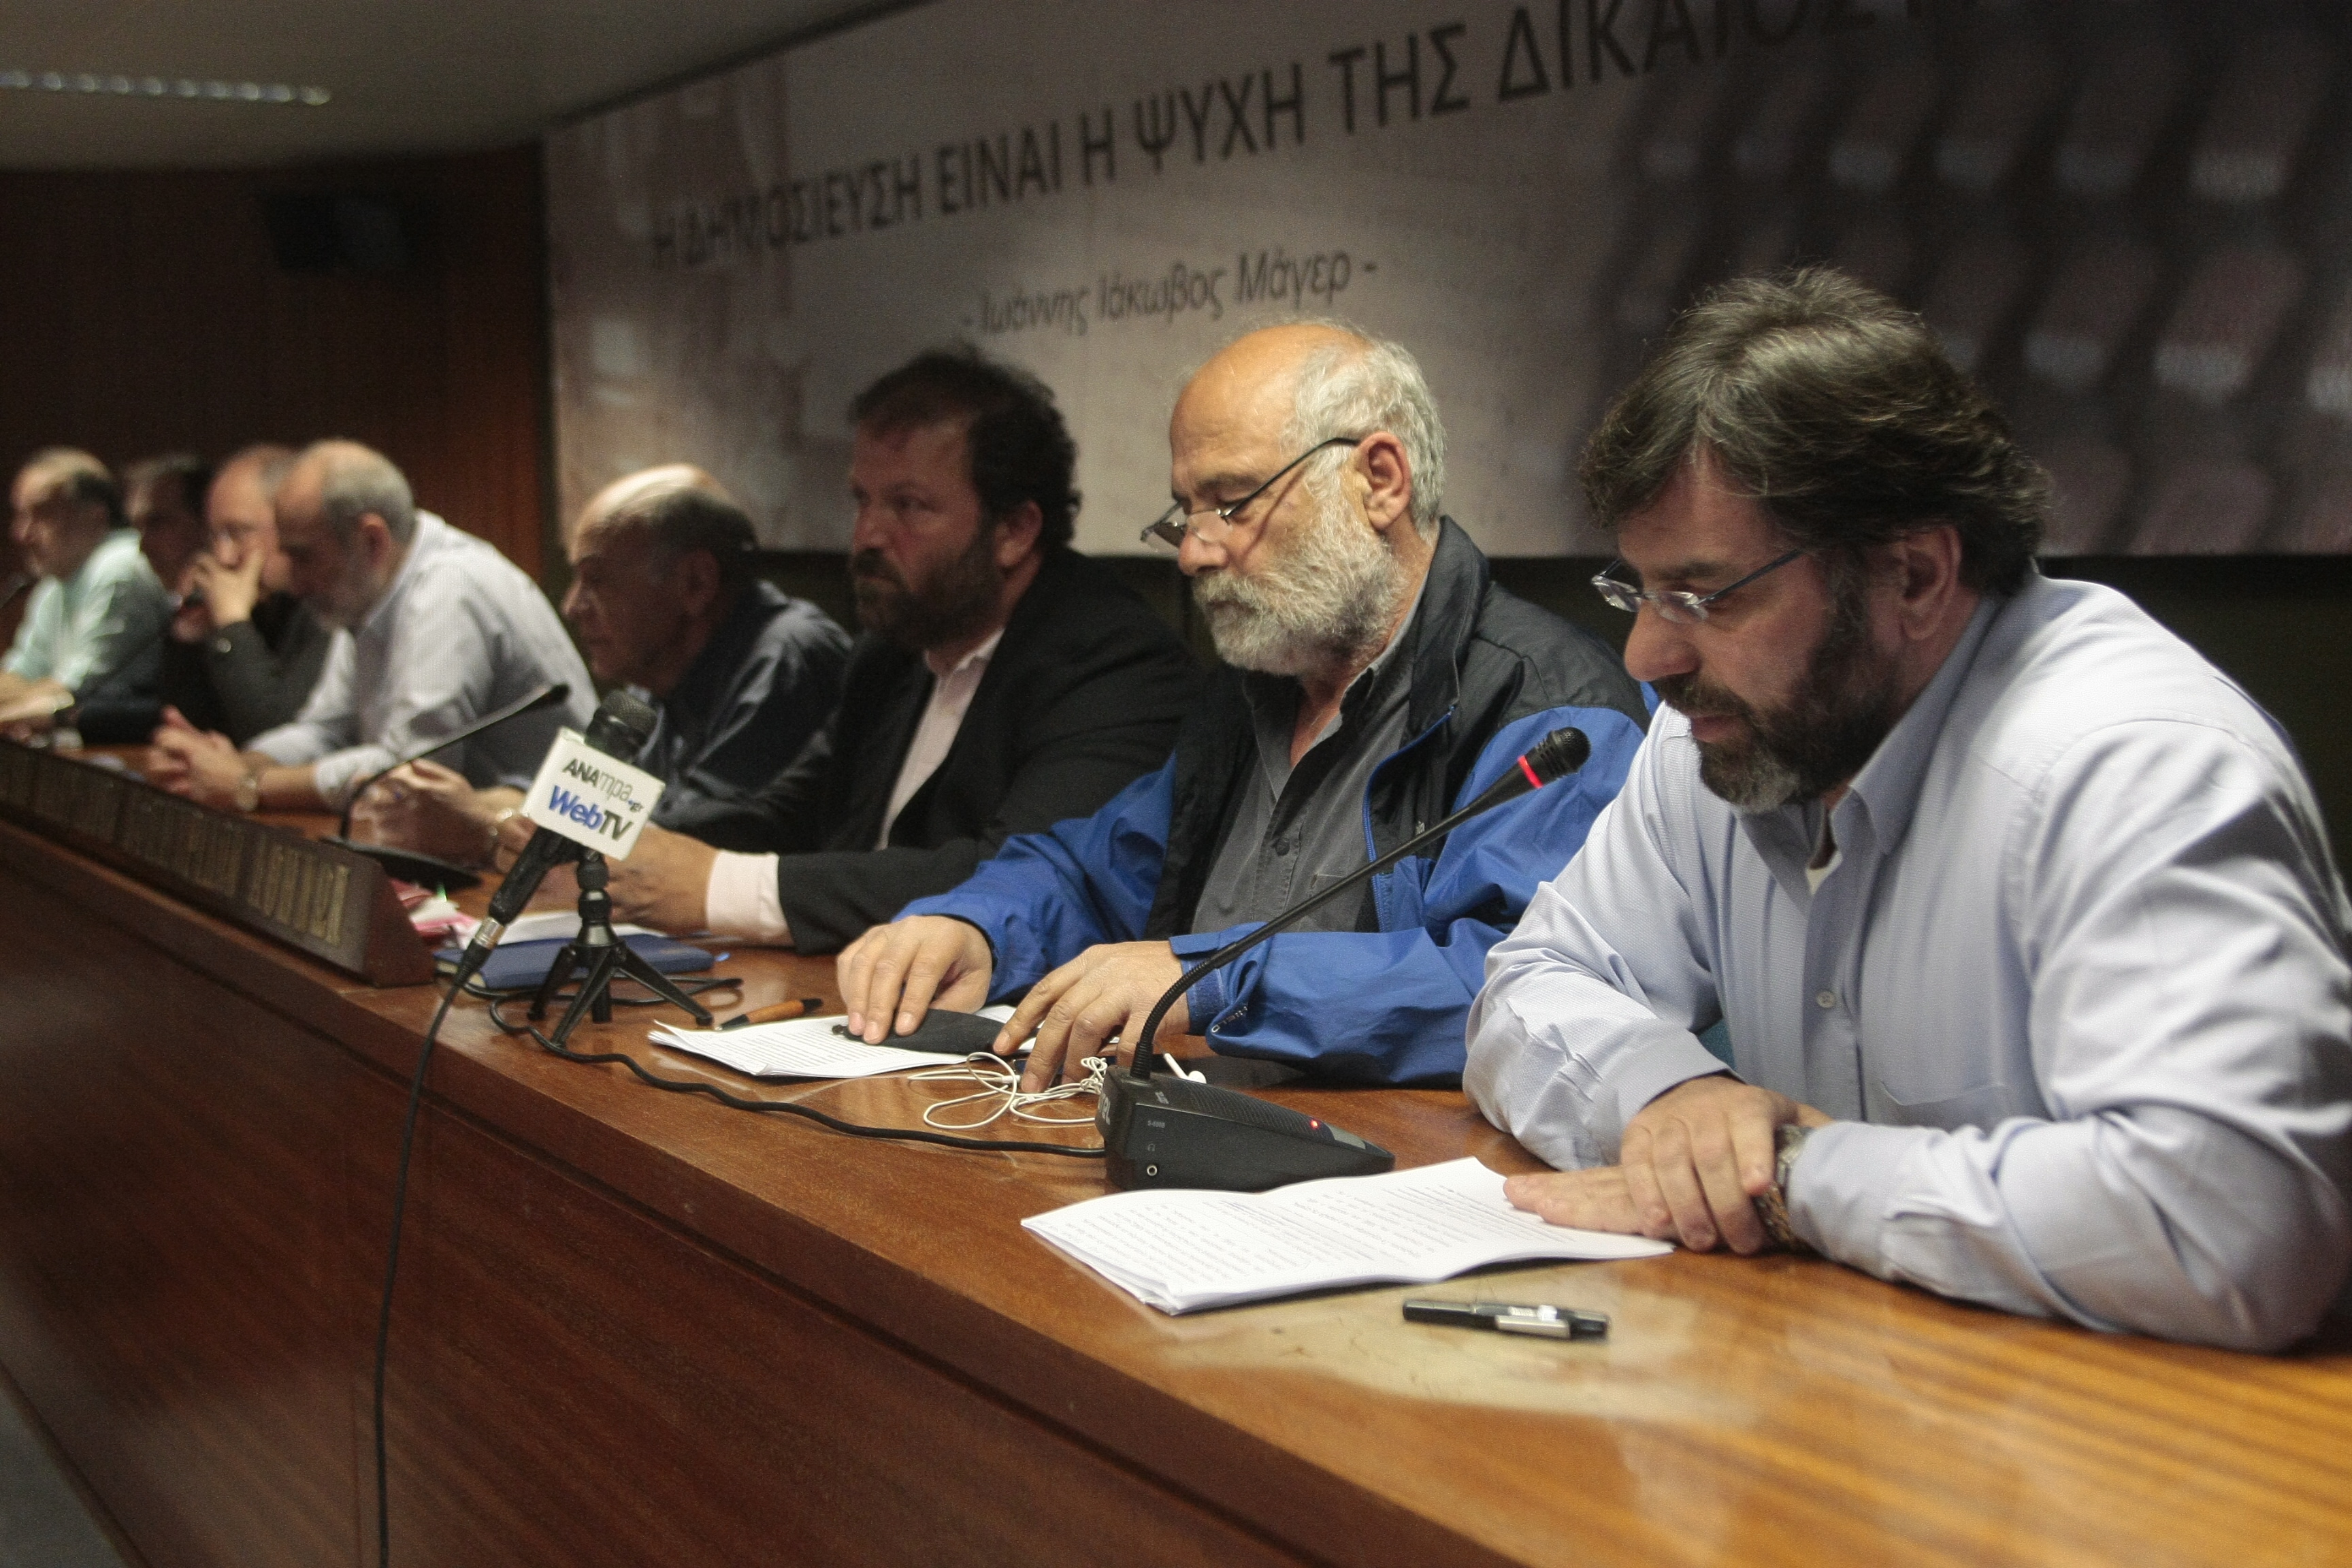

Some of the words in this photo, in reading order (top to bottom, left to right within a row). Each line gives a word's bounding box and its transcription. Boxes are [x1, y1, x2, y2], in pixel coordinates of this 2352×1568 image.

[938, 118, 1062, 216] ΕΙΝΑΙ
[1079, 108, 1117, 186] Η
[1134, 62, 1305, 176] ΨΥΧΗ
[1328, 21, 1471, 134] ΤΗΣ
[1235, 245, 1353, 310] Μάγερ
[549, 785, 634, 840] WebTV
